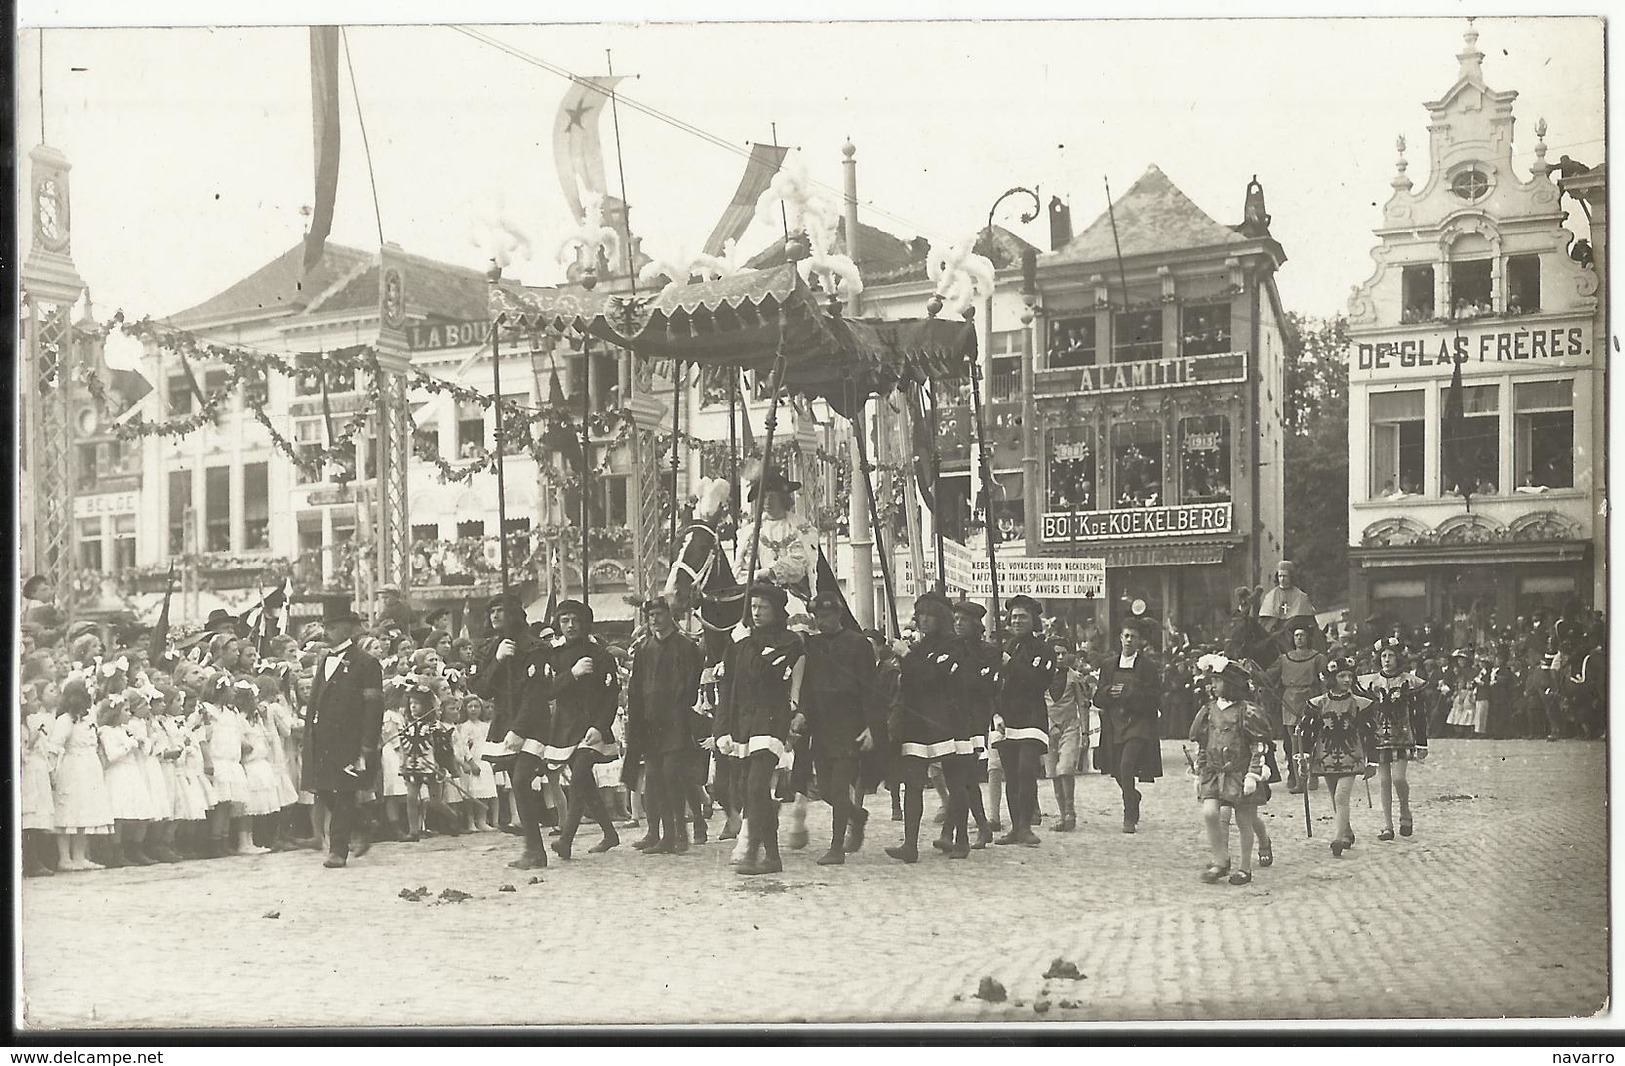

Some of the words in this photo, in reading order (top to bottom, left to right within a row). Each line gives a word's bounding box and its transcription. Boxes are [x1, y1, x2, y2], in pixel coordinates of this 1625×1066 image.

[1401, 336, 1469, 367] GLAS
[1092, 522, 1107, 534] DE
[1109, 507, 1225, 534] KOEKELBERG
[1009, 562, 1044, 570] VOYAGEURS
[1009, 585, 1031, 593] LIGNES
[1036, 584, 1059, 594] ANVERS
[1062, 585, 1070, 593] ET
